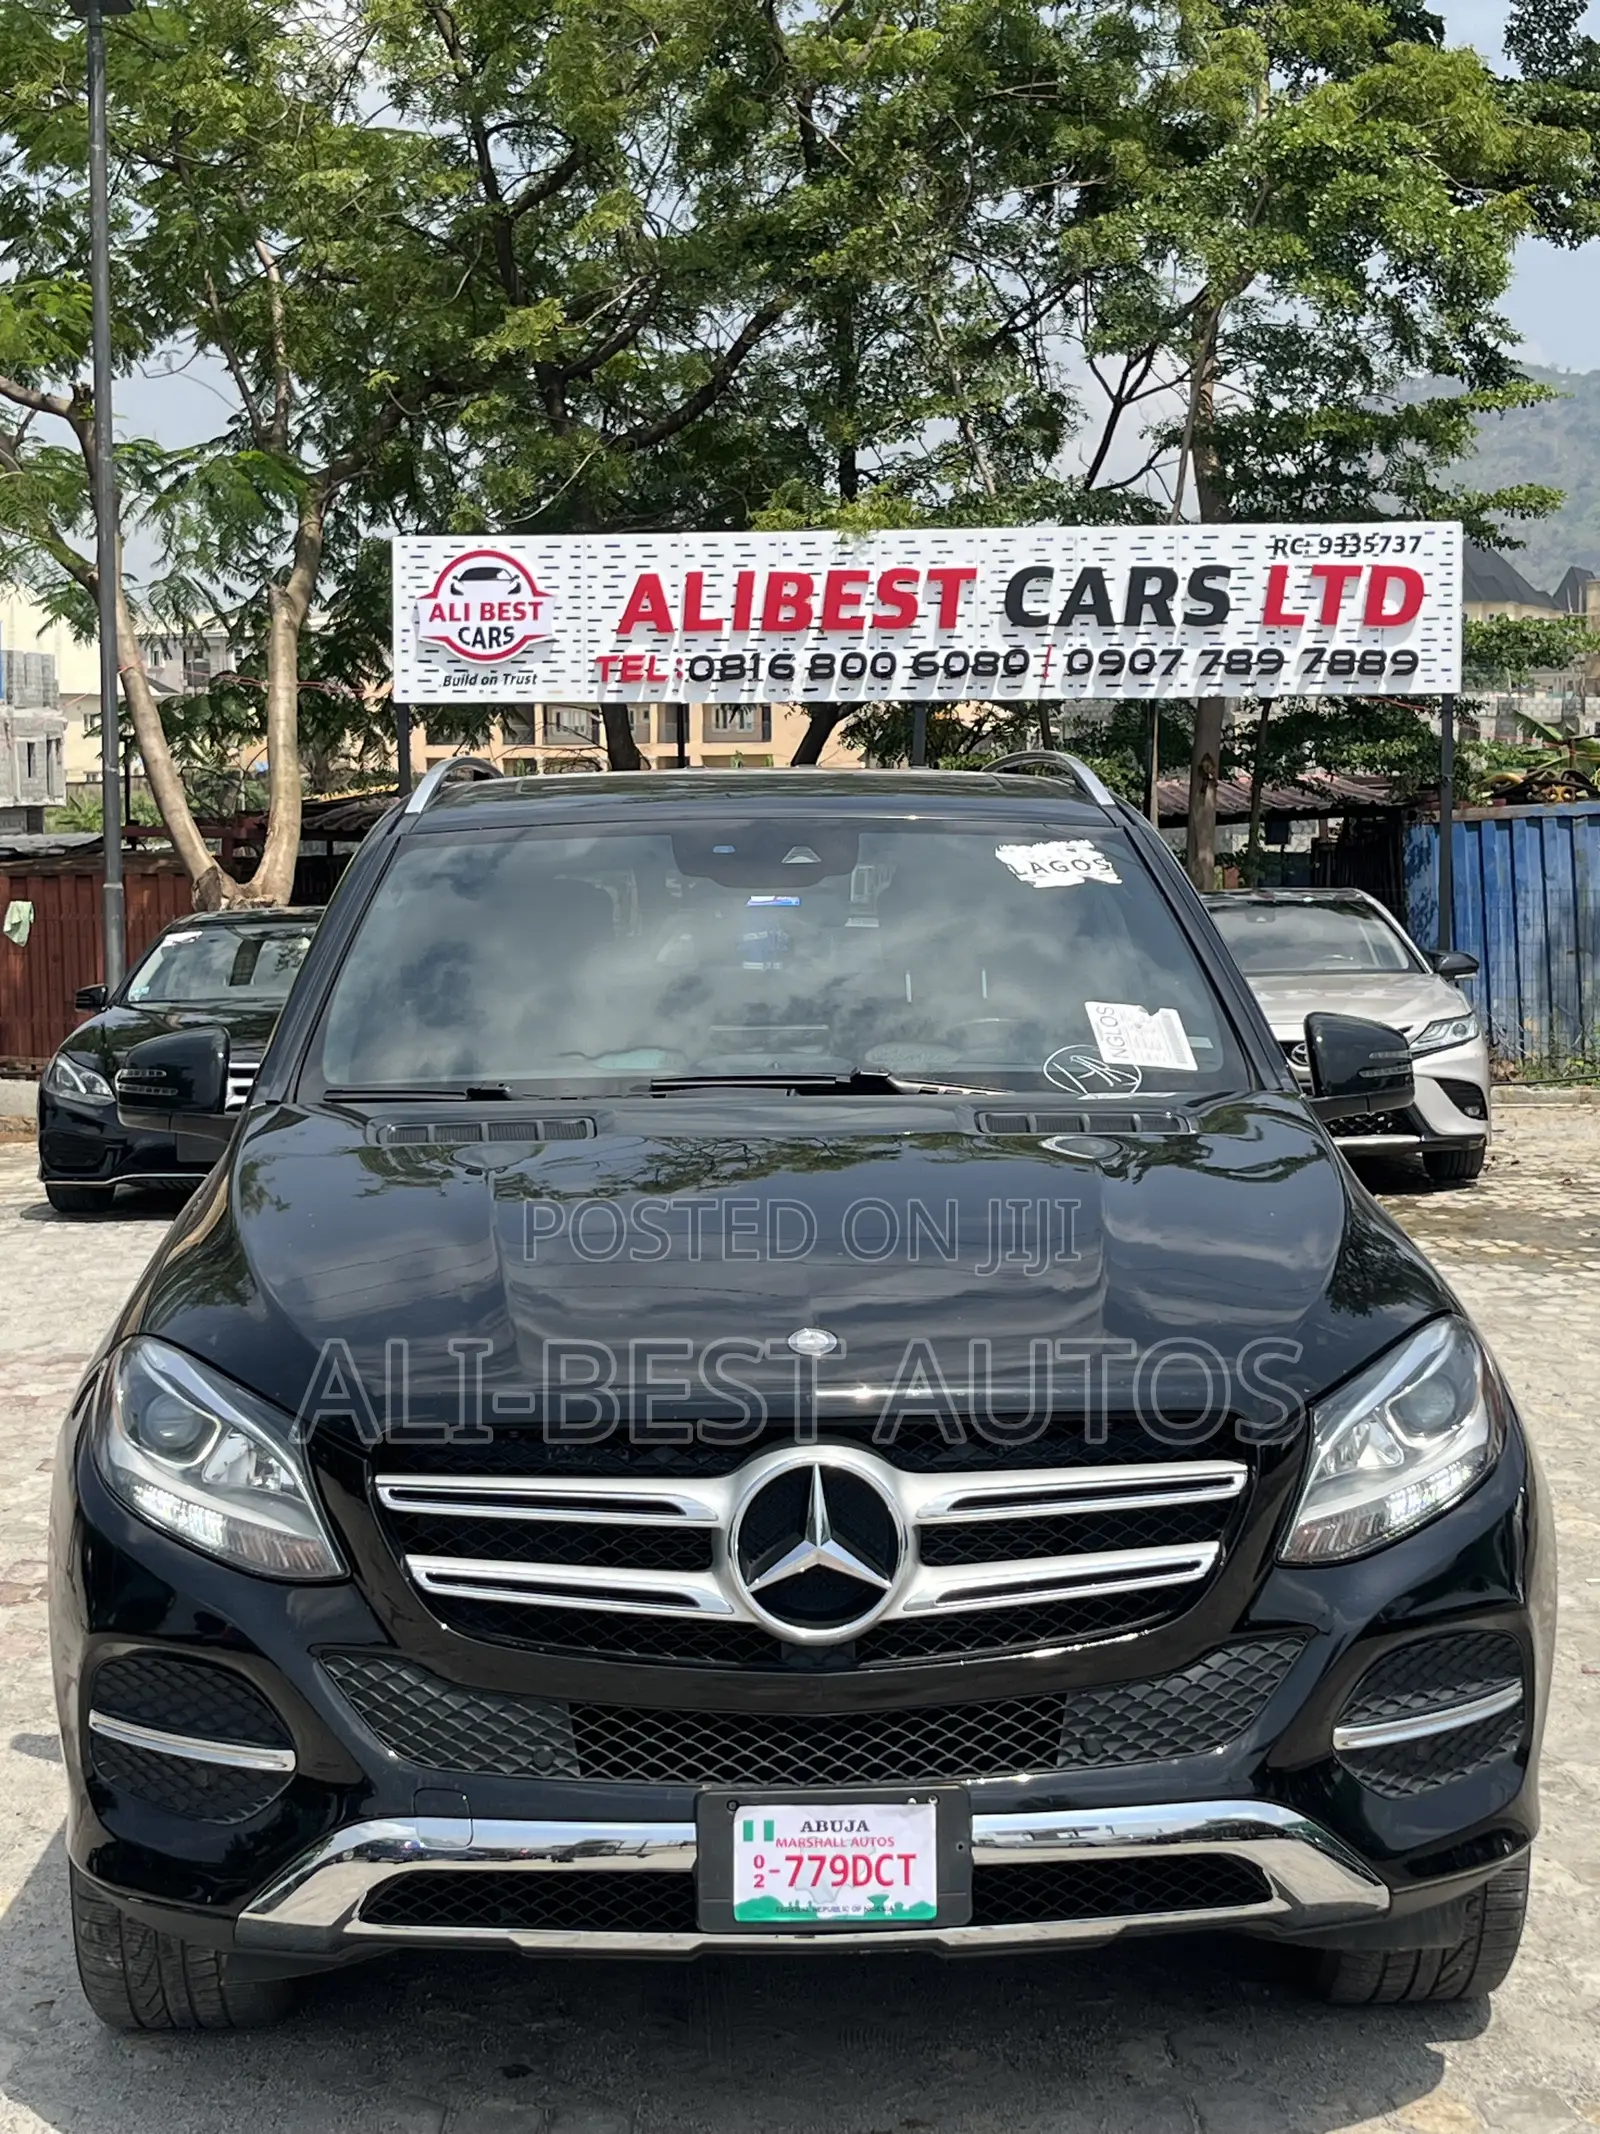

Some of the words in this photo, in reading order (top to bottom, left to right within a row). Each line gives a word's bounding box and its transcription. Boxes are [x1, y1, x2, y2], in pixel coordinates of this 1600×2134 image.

[1318, 534, 1422, 555] 9335737
[616, 566, 978, 635] ALIBEST
[1003, 564, 1232, 628] CARS
[1262, 563, 1426, 628] LTD
[429, 602, 471, 622] ALI
[480, 601, 544, 622] BEST
[458, 625, 515, 649] CARS
[808, 651, 897, 681] 800
[911, 649, 1030, 679] 6080
[1066, 648, 1184, 676] 0907
[1198, 647, 1285, 676] 789
[1302, 647, 1419, 676] 7889
[442, 673, 479, 687] Build
[481, 676, 498, 686] on
[503, 673, 538, 685] Trust
[800, 1819, 870, 1833] ABUJA
[775, 1836, 847, 1849] MARSHALL
[850, 1836, 895, 1848] AUTOS
